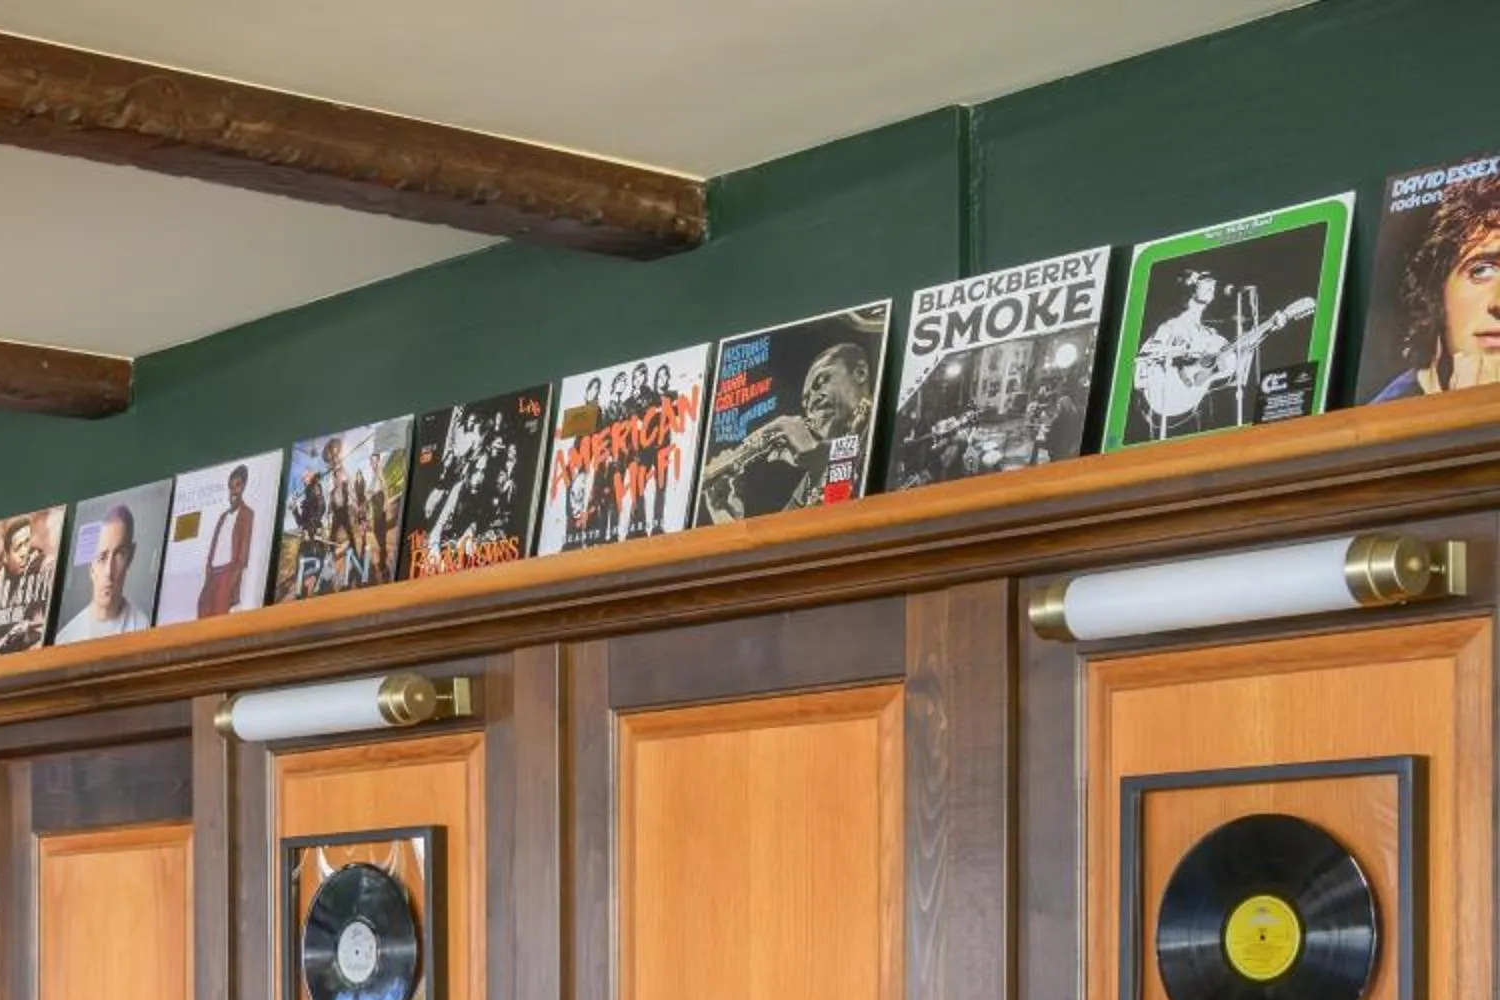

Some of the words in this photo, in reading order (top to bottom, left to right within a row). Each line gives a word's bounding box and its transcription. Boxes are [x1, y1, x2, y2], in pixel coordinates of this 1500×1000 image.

[1392, 170, 1446, 198] DAVID
[1446, 156, 1500, 184] ESSEX
[911, 279, 1096, 357] SMOKE
[918, 252, 1101, 315] BLACKBERRY
[551, 383, 701, 506] AMERICAN
